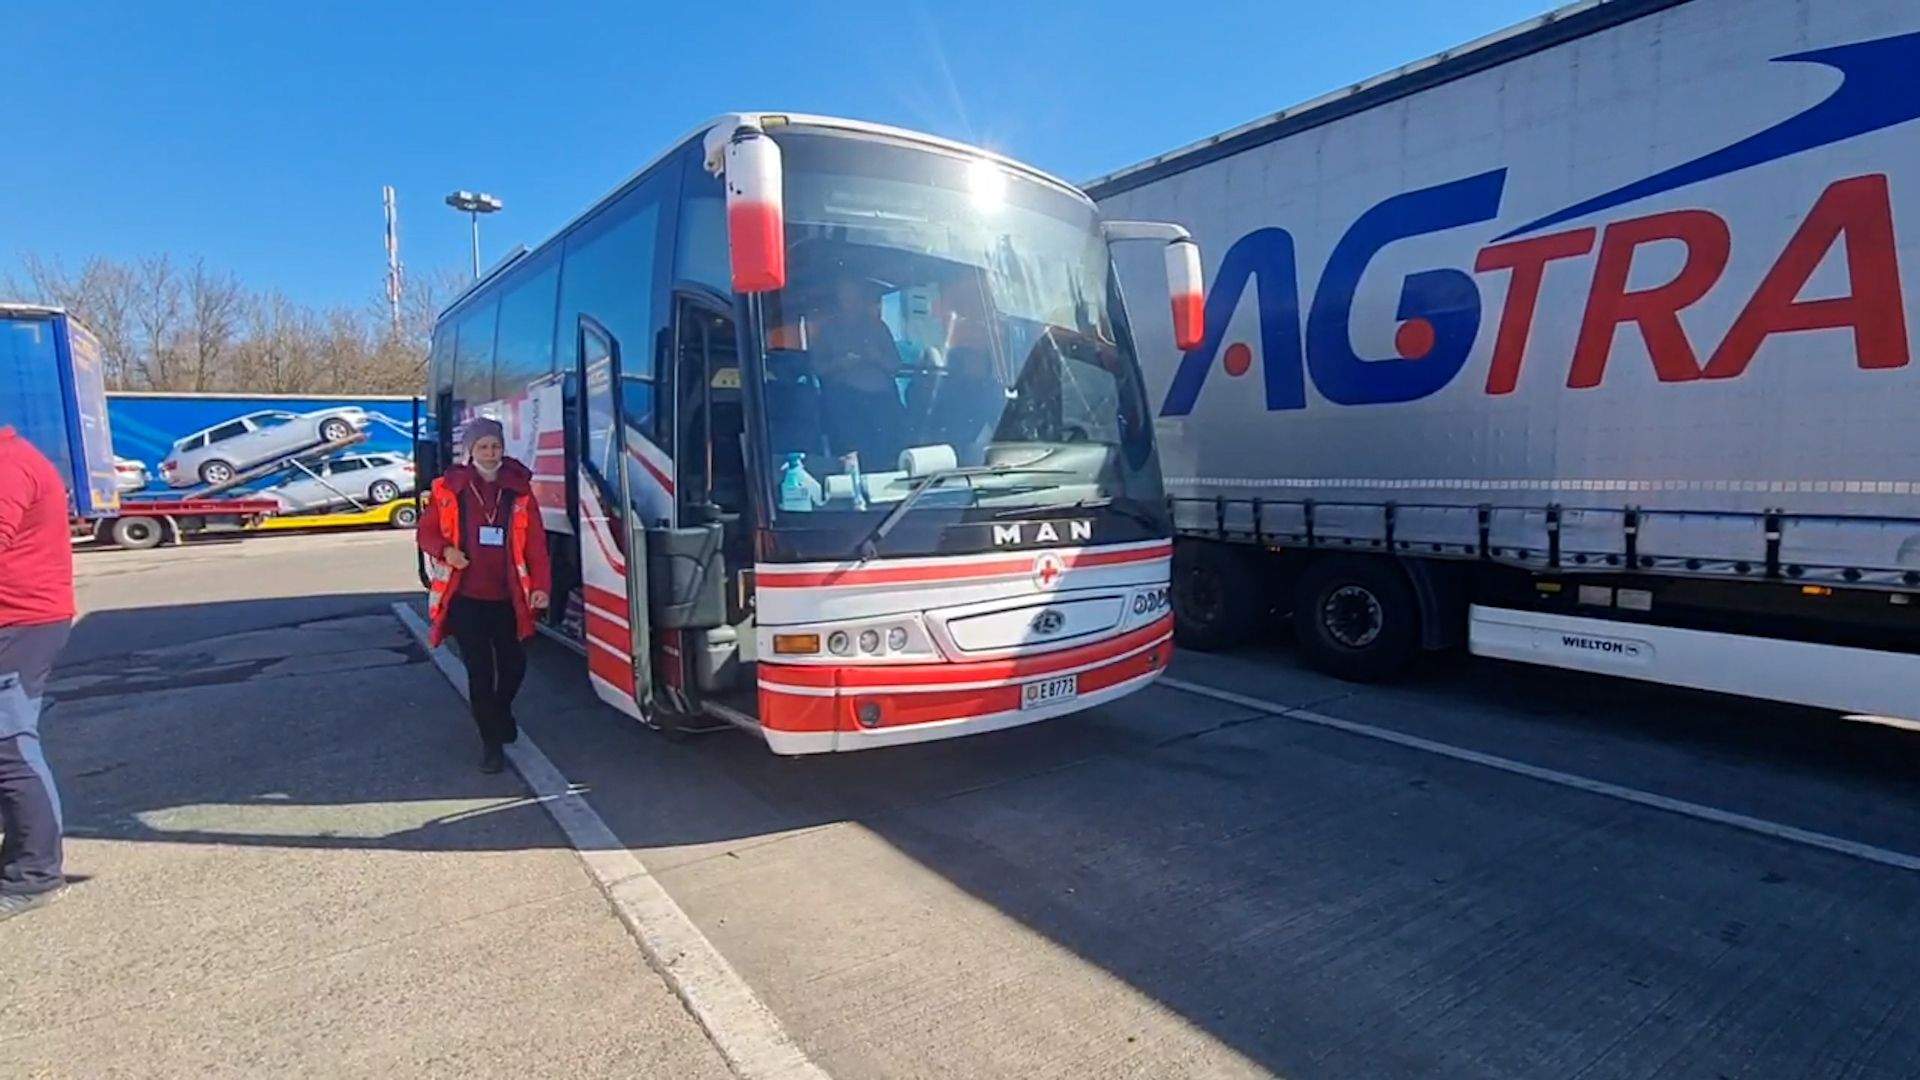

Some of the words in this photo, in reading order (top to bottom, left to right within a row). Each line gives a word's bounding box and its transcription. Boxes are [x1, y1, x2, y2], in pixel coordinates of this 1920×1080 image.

[993, 520, 1092, 545] MAN
[1562, 636, 1623, 653] WIELTON
[1049, 678, 1074, 697] 8773
